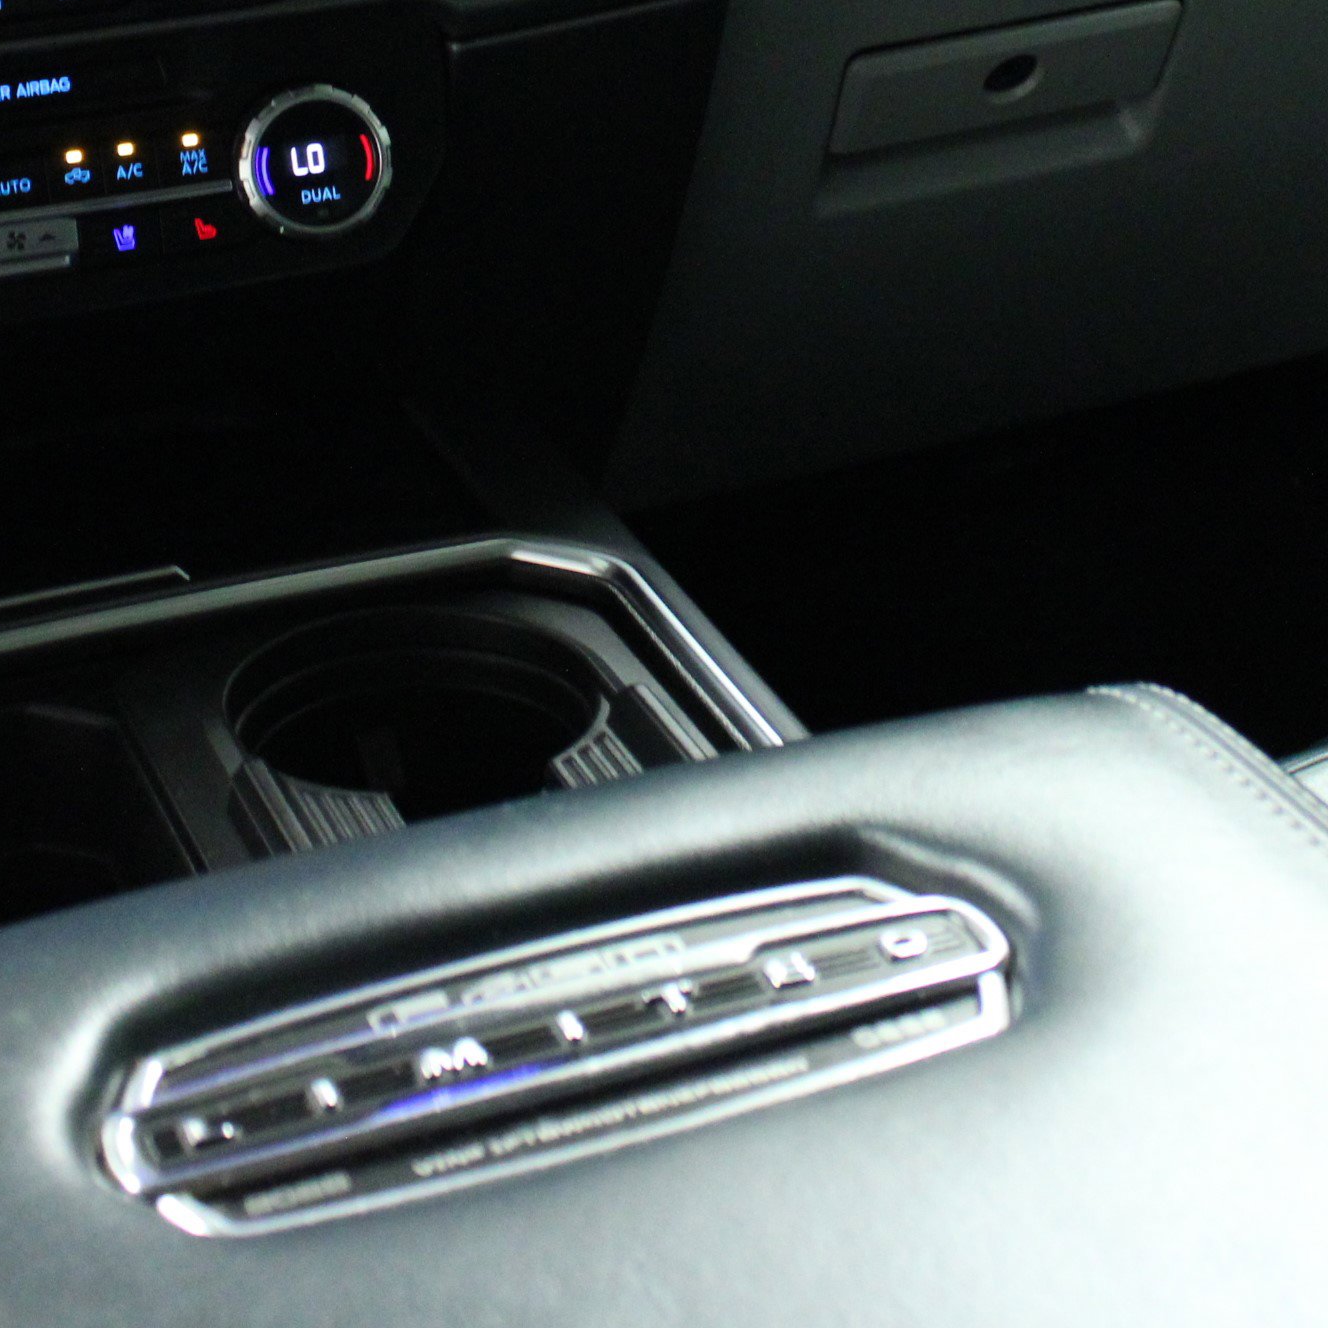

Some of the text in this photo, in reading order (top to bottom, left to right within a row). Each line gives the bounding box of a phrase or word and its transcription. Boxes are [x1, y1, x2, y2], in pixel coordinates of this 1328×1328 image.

[16, 75, 72, 100] AIRBAG
[179, 149, 207, 163] MAX
[291, 142, 325, 177] LO
[116, 162, 144, 180] A/C
[181, 159, 209, 176] A/C
[301, 186, 342, 205] DUAL
